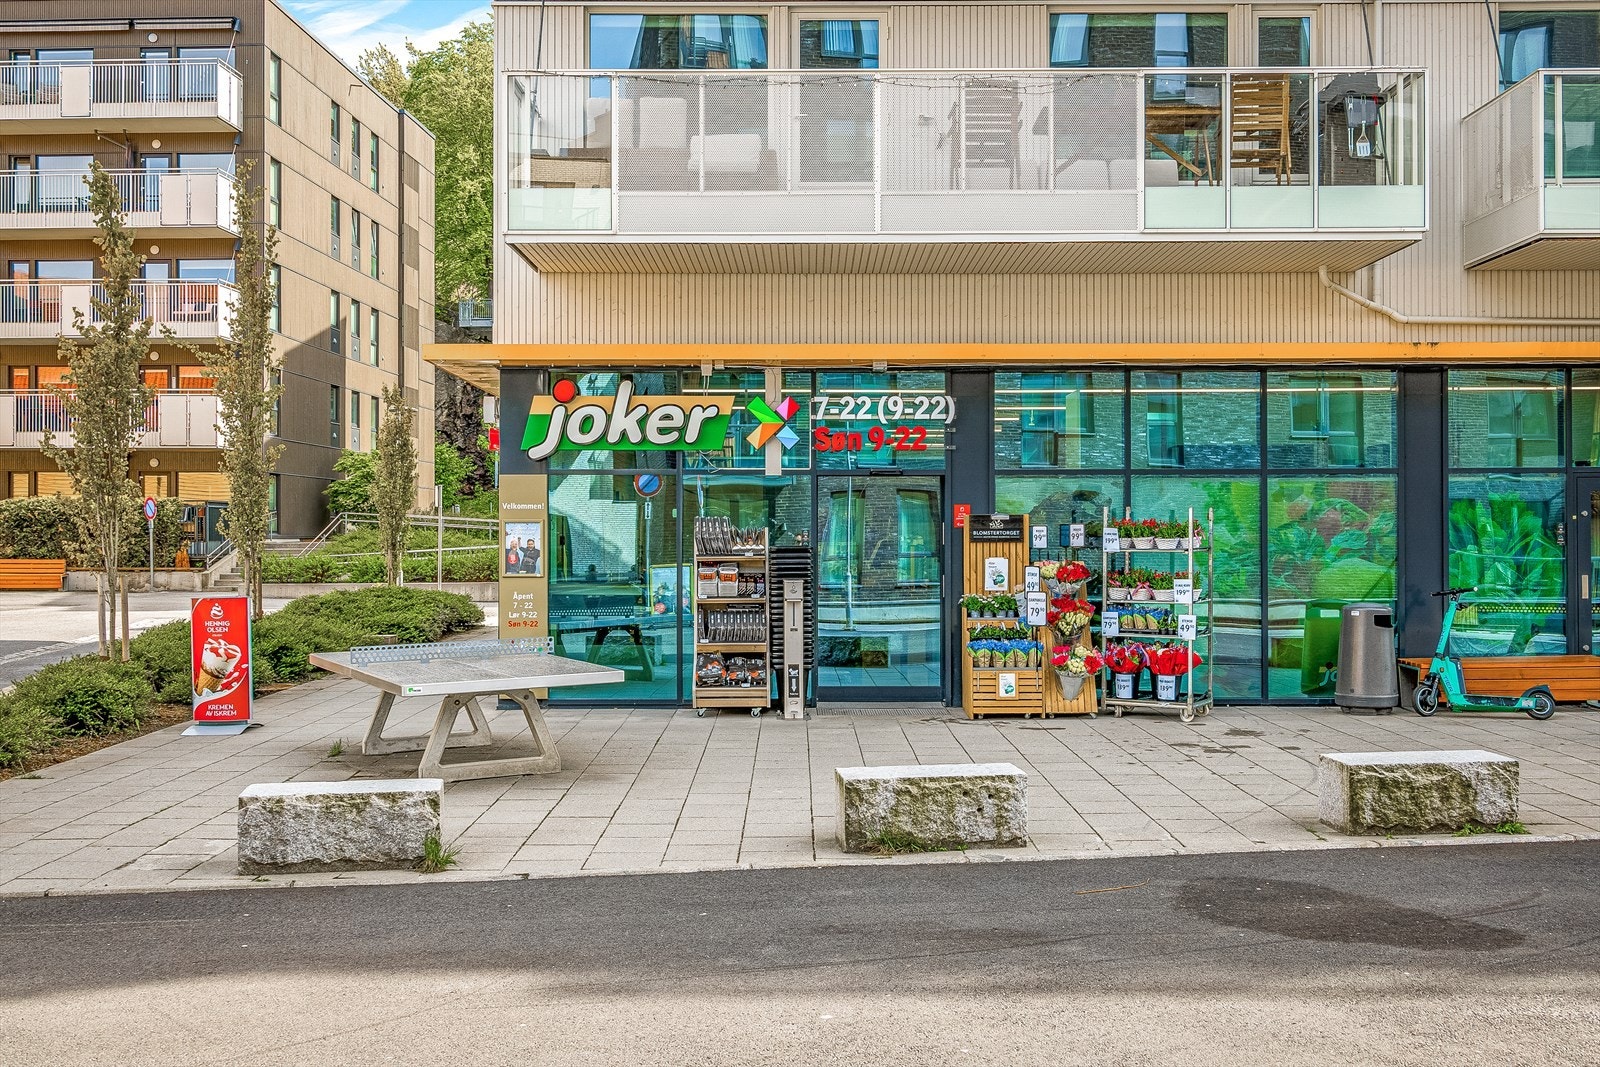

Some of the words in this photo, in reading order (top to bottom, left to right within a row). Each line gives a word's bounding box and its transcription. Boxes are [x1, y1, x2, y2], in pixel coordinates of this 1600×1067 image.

[813, 396, 872, 420] 7-22
[877, 396, 956, 424] (9-22)
[527, 379, 720, 461] joker
[814, 426, 862, 452] Søn
[868, 426, 927, 451] 9-22
[502, 502, 545, 510] Velkommen!
[513, 591, 533, 600] Åpent
[508, 611, 520, 619] Lør
[521, 611, 538, 619] 9-22
[508, 620, 521, 628] Søn
[522, 620, 539, 628] 9-22
